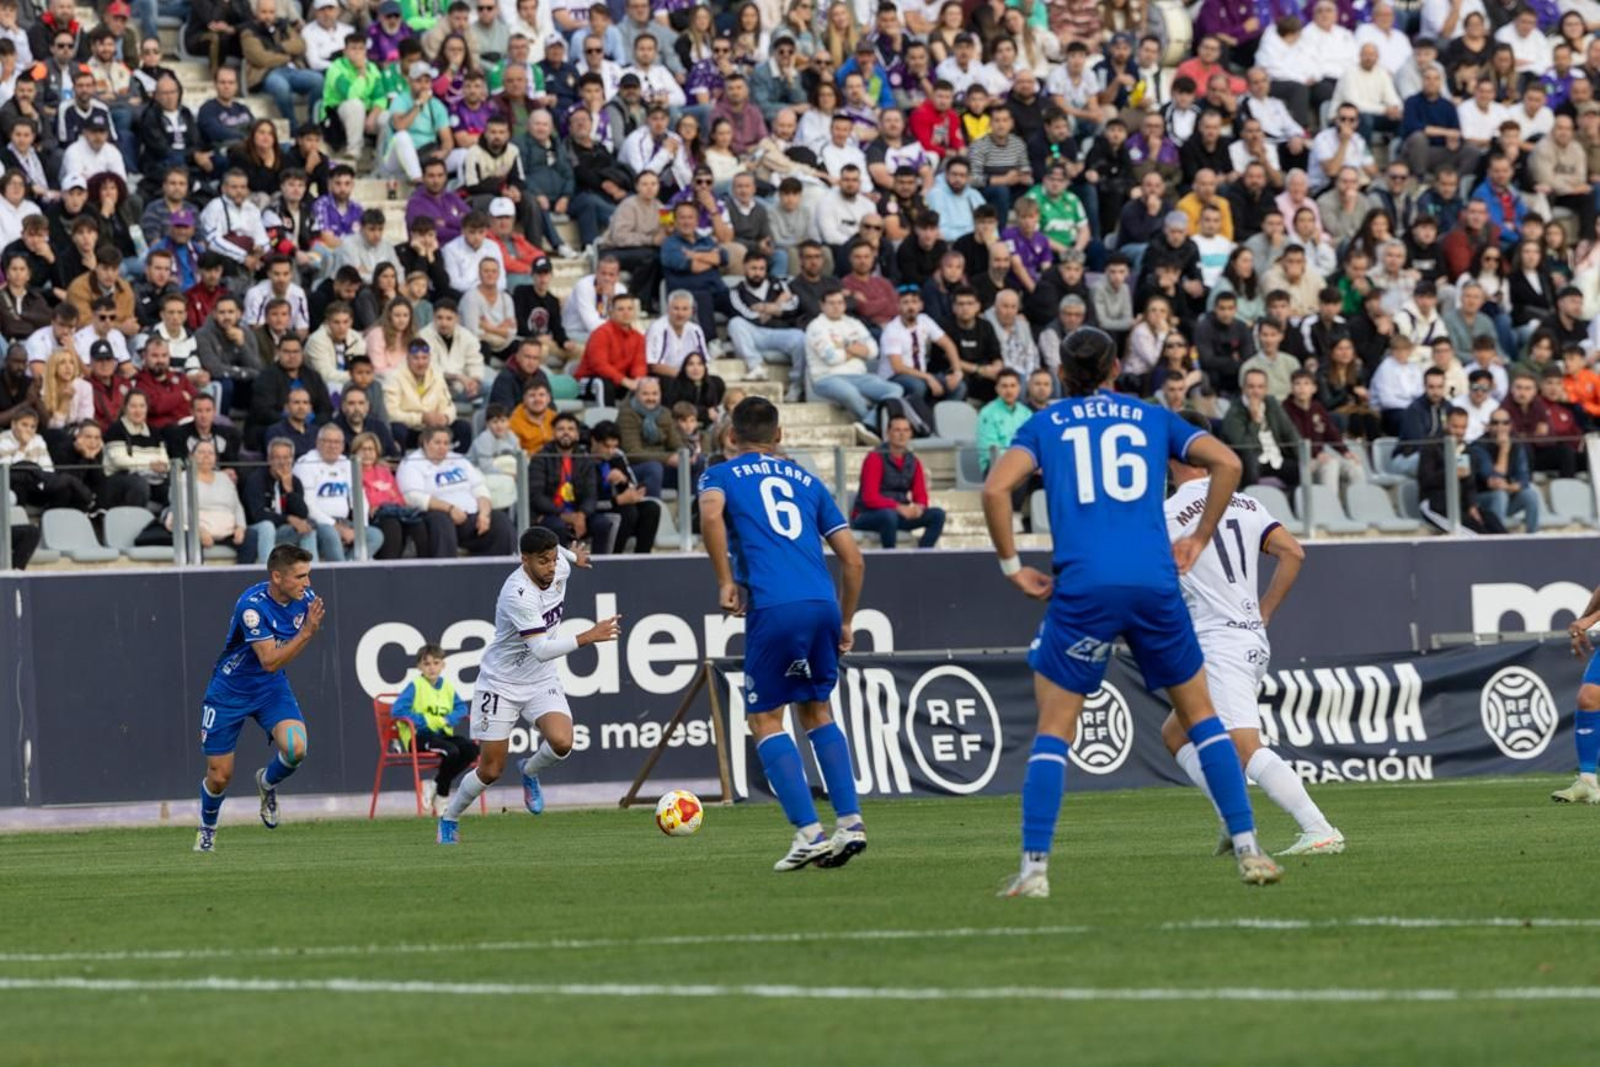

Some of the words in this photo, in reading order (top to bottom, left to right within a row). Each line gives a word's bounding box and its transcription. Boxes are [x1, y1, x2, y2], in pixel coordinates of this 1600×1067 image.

[1051, 411, 1070, 425] C.
[1072, 401, 1143, 421] BECKEN
[732, 461, 771, 478] FRAN
[774, 462, 812, 487] LARA
[1061, 423, 1148, 504] 16
[759, 476, 803, 541] 6
[1176, 495, 1209, 527] MARI
[1212, 518, 1249, 584] 11
[480, 691, 501, 716] 21
[926, 699, 976, 725] RF
[1505, 699, 1529, 714] RF
[202, 705, 216, 729] 10
[1082, 711, 1107, 725] RF
[1507, 714, 1533, 729] EF
[1083, 727, 1108, 742] EF
[931, 734, 982, 761] EF
